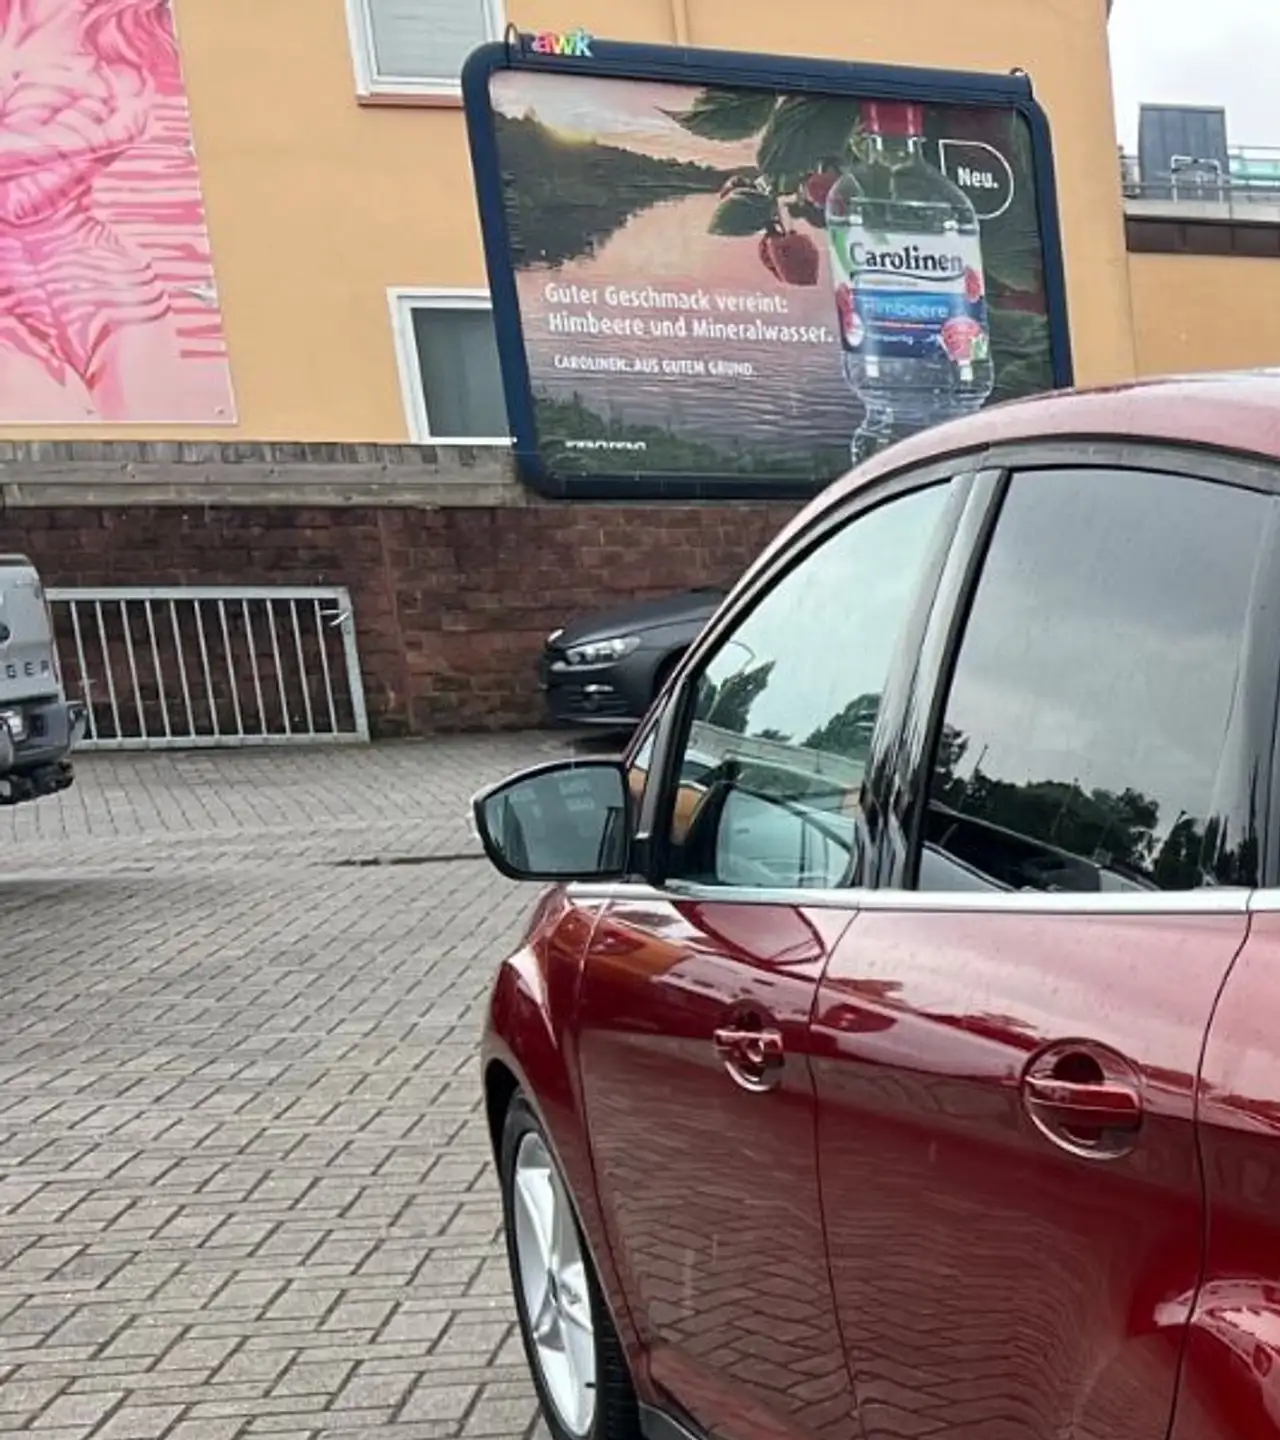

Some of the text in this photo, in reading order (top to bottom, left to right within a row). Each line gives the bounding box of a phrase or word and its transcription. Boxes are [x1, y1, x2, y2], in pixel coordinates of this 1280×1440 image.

[957, 166, 999, 189] Neu.
[849, 242, 964, 272] Carolinen
[545, 282, 789, 314] Guter Geschmack vereint:
[549, 312, 835, 344] Himbeere und Mineralwasser.
[634, 357, 660, 374] AUS
